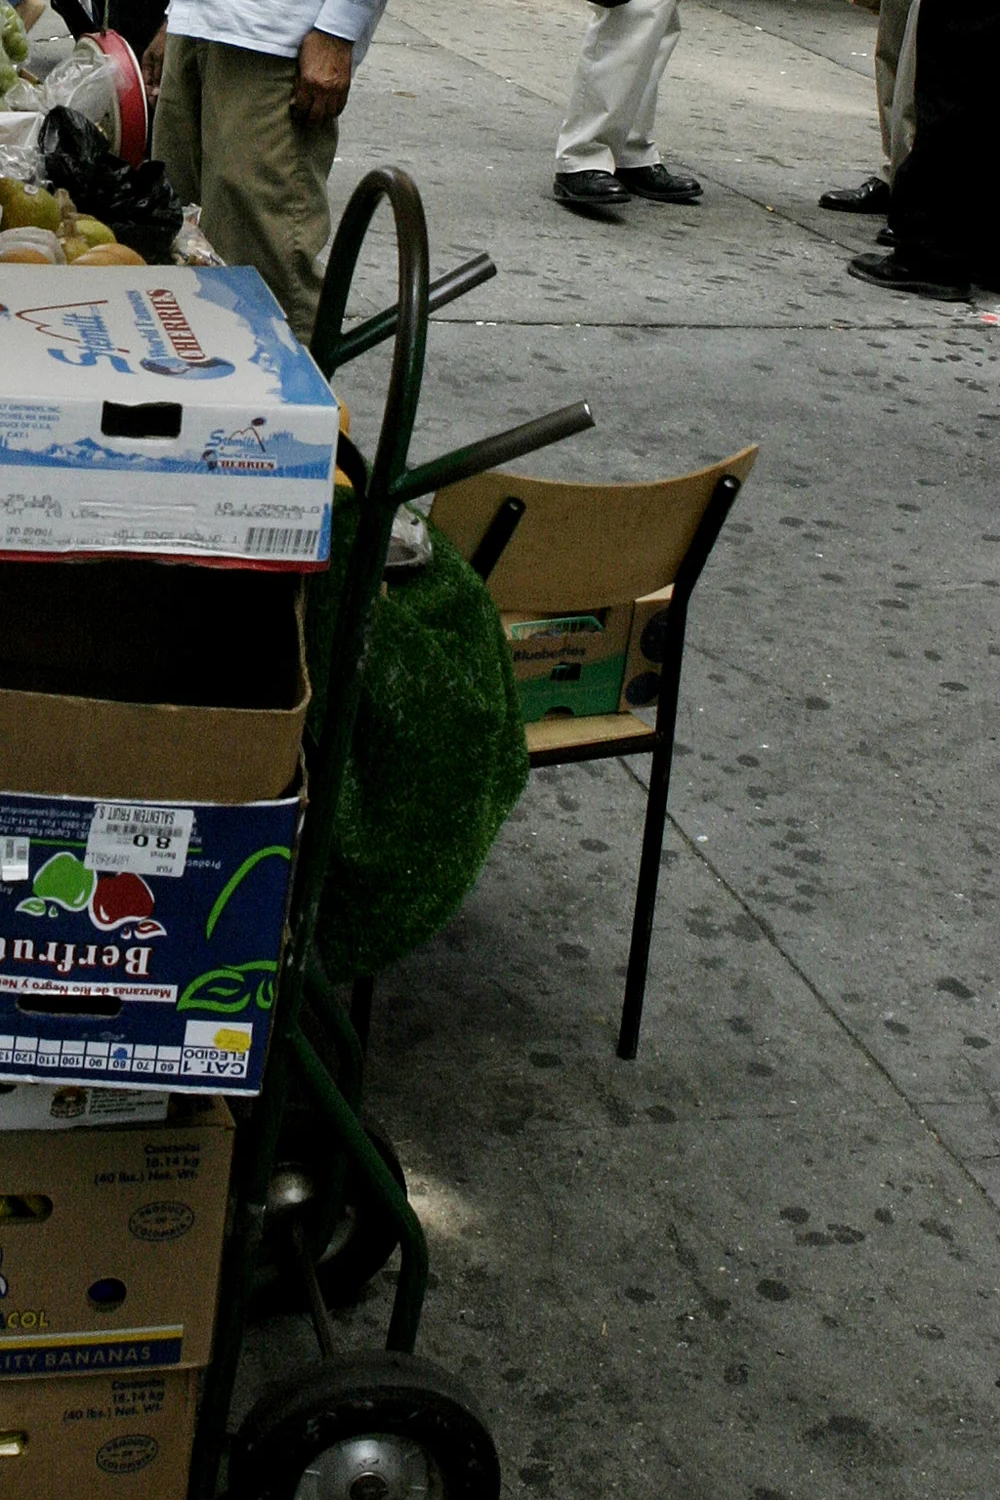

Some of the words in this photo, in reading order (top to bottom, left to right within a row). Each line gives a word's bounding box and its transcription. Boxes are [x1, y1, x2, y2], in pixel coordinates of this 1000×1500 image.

[146, 288, 206, 361] CHERRIES
[47, 310, 137, 374] Stemilt
[107, 808, 131, 821] FRUIT
[133, 810, 176, 825] SALENTEIN
[21, 980, 29, 989] y
[32, 982, 69, 994] Negro
[95, 986, 110, 995] de
[112, 986, 171, 998] Manzanas
[15, 1052, 34, 1062] 120
[39, 1054, 56, 1064] 110
[61, 1056, 80, 1066] 100
[183, 1048, 246, 1062] ELEGIDO
[88, 1057, 103, 1067] 90
[112, 1059, 126, 1069] 80
[136, 1061, 150, 1070] 70
[160, 1062, 174, 1071] 60
[183, 1060, 192, 1073] 1
[200, 1060, 245, 1076] CAT.
[146, 1156, 180, 1168] 18.14
[183, 1155, 200, 1168] kg
[94, 1172, 116, 1186] (40
[44, 1345, 153, 1368] BANANAS
